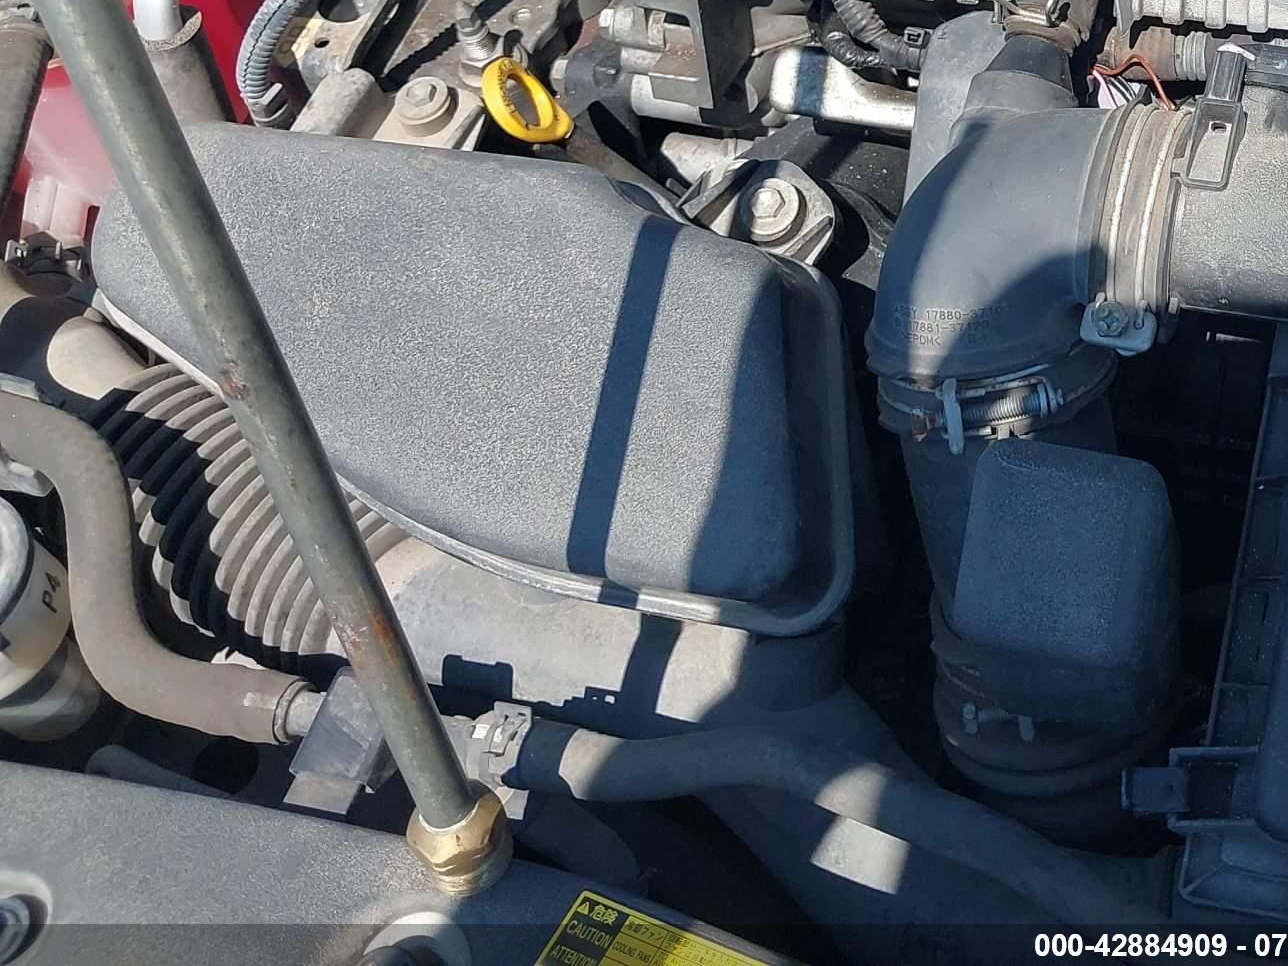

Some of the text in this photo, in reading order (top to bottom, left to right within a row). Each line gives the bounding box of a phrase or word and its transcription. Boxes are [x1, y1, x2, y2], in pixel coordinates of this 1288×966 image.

[42, 572, 61, 613] P4
[589, 904, 618, 926] 危険
[566, 920, 614, 948] CAUTION
